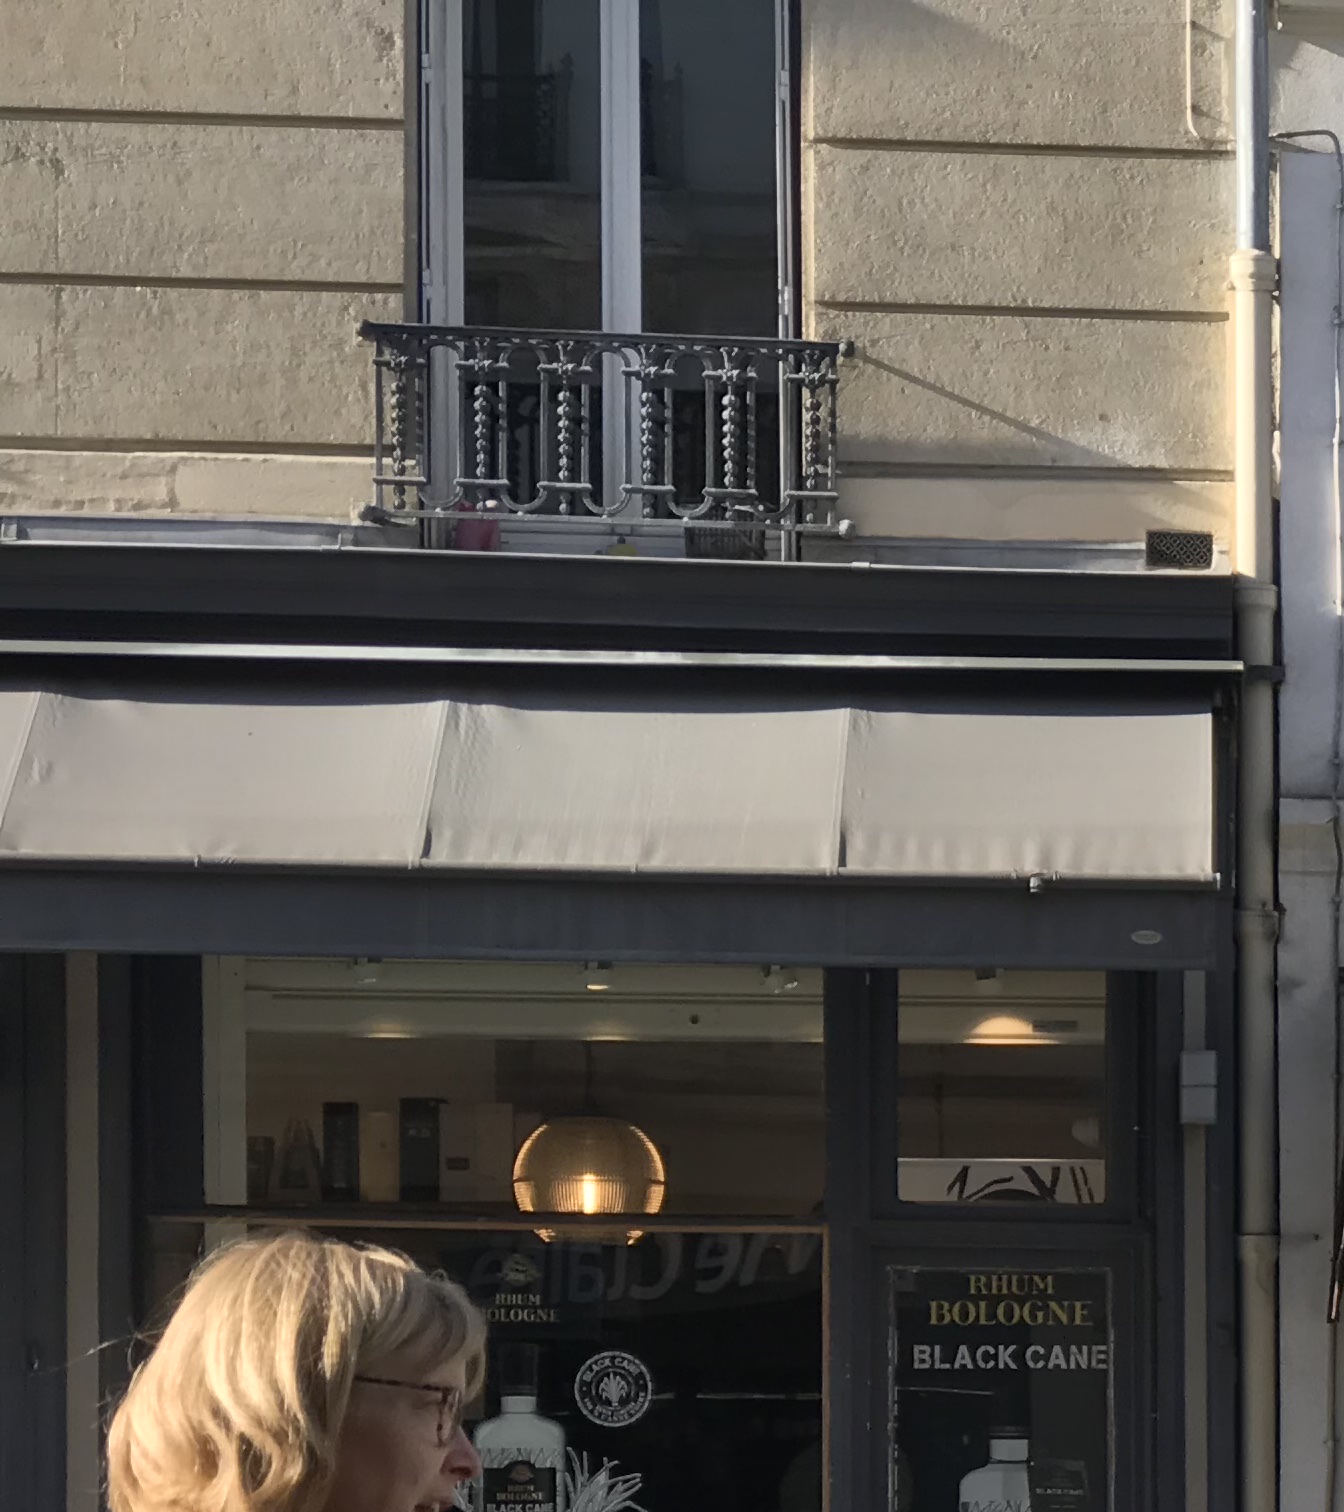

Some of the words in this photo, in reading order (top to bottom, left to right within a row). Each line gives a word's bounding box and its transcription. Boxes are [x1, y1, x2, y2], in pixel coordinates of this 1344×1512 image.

[969, 1274, 1055, 1295] RHUM
[494, 1293, 541, 1306] RHUM
[928, 1300, 1094, 1326] BOLOGNE
[912, 1344, 1018, 1369] BLACK
[1025, 1344, 1109, 1370] CANE
